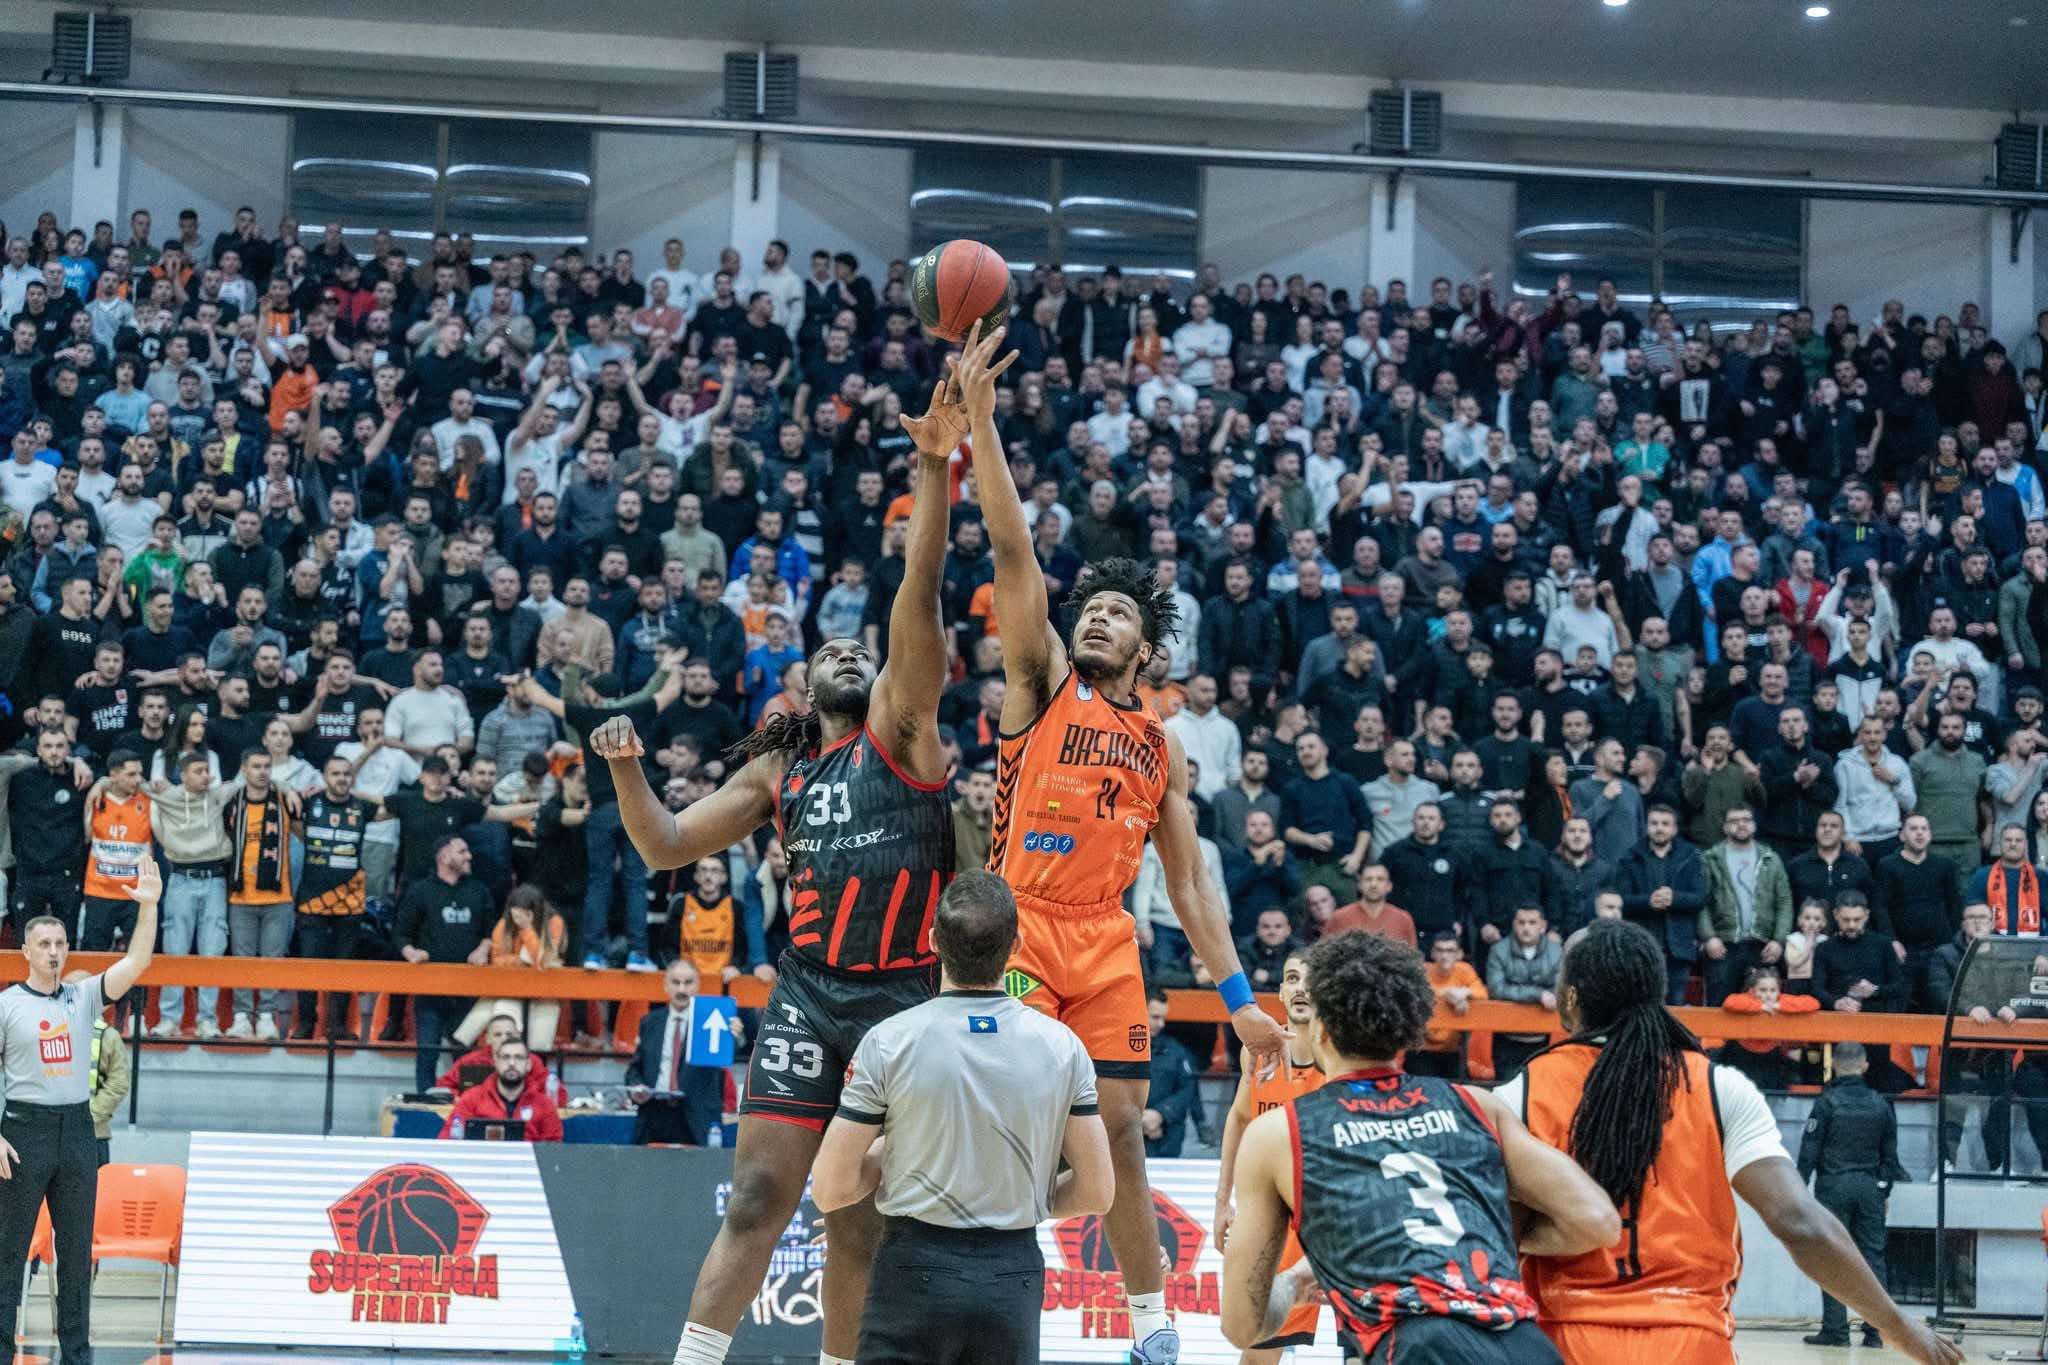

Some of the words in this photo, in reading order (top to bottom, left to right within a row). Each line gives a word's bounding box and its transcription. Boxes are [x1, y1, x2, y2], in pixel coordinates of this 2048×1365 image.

[61, 629, 92, 644] BOSS
[316, 713, 357, 726] SINCE
[806, 782, 852, 826] 33
[1096, 777, 1123, 820] 24
[760, 1037, 823, 1079] 33
[1332, 1110, 1460, 1148] ANDERSON
[1379, 1151, 1465, 1247] 3
[309, 1248, 500, 1300] SUPERLIGA
[1042, 1268, 1220, 1315] SUPEIGA
[352, 1294, 451, 1324] FEMRAT
